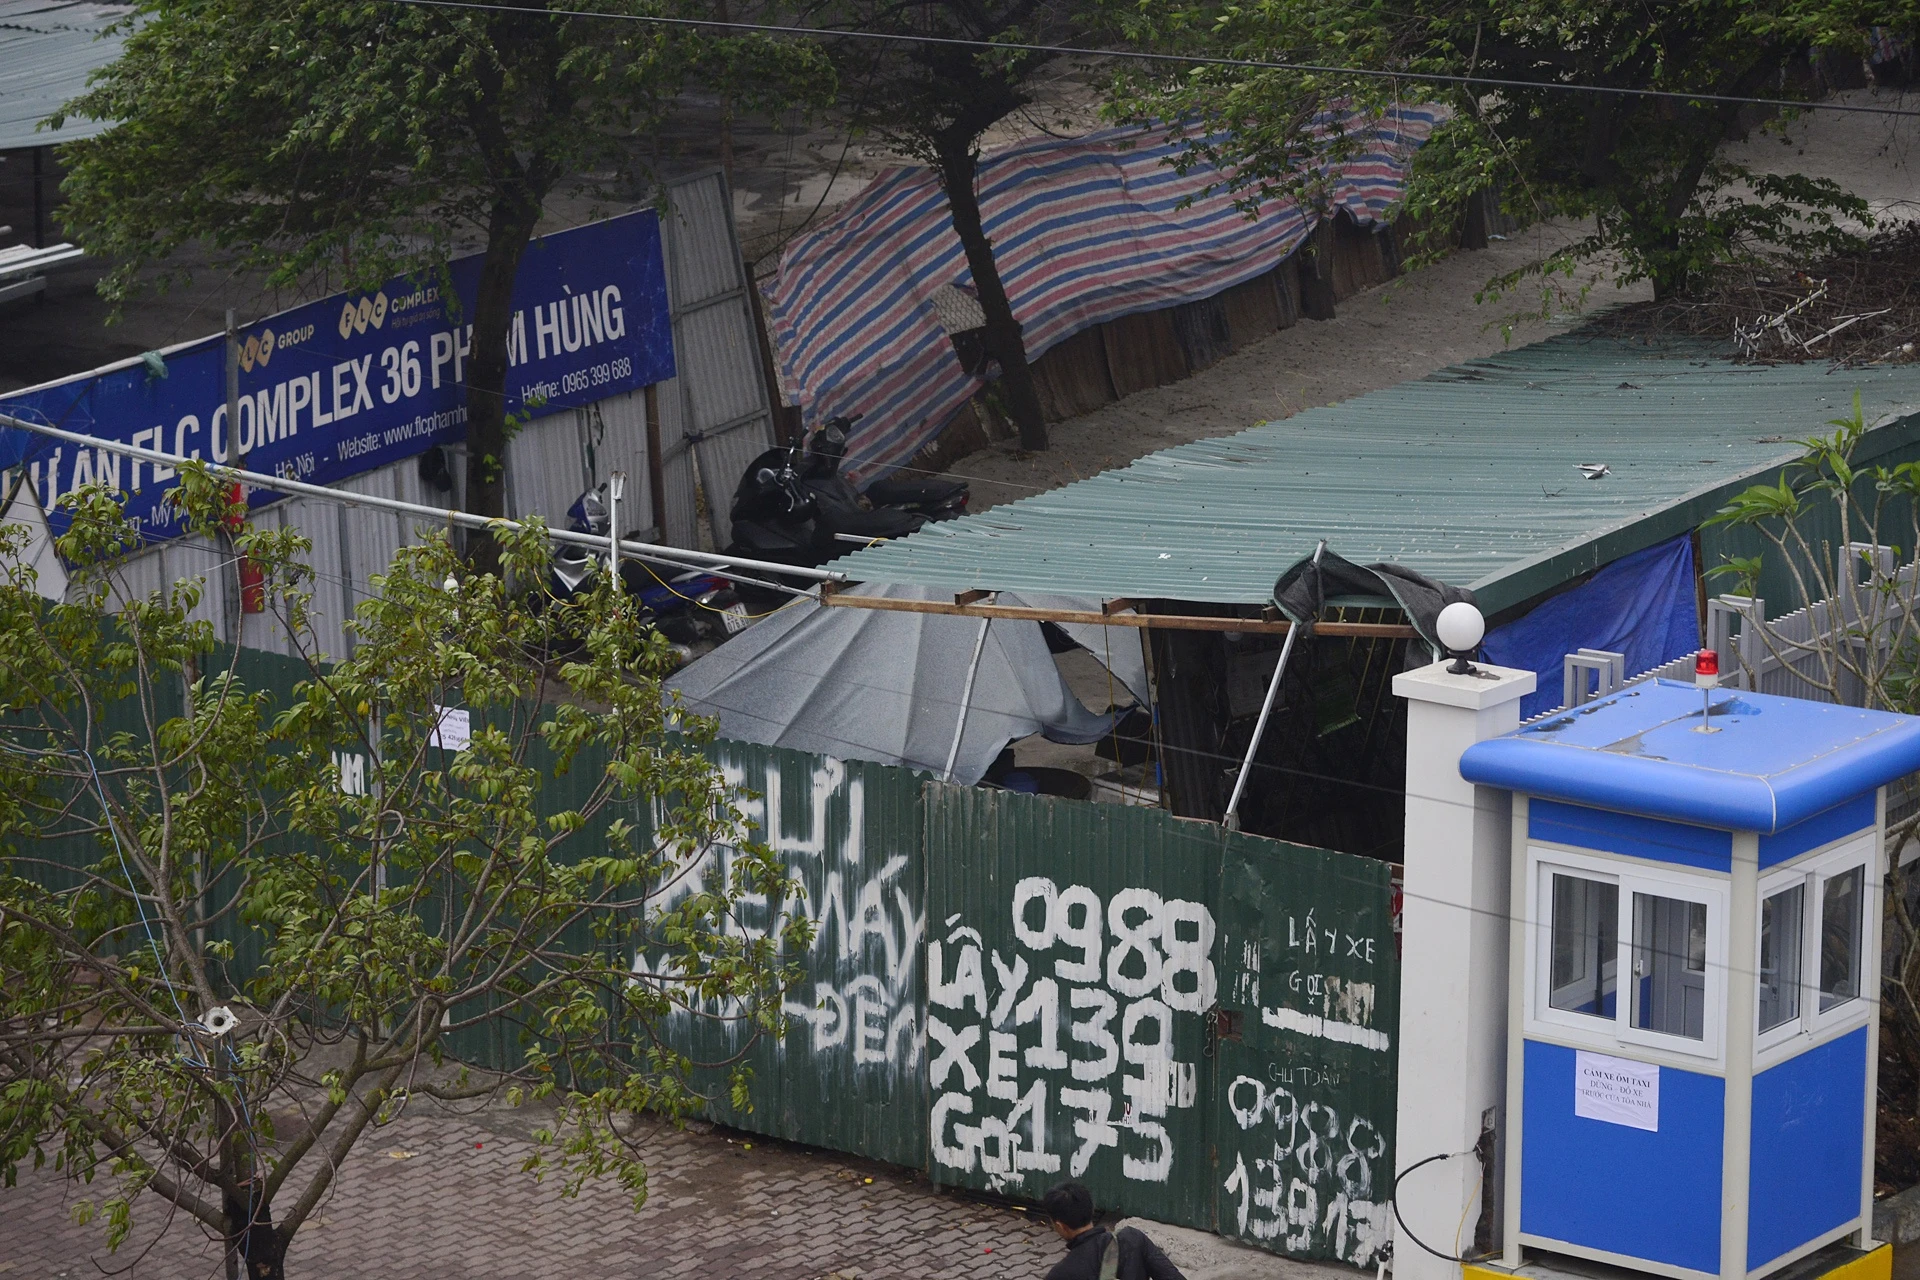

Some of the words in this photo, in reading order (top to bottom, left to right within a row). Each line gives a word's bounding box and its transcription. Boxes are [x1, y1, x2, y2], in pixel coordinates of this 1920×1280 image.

[277, 324, 315, 350] GROUP
[391, 286, 440, 314] COMPLEX
[131, 415, 201, 491] FLC
[210, 353, 374, 465] COMPLEX
[380, 340, 422, 404] 36
[430, 309, 529, 390] PHM
[534, 283, 626, 360] HÙNG
[296, 450, 316, 475] Nội
[337, 431, 382, 463] Website:
[521, 381, 561, 404] Hotline:
[562, 368, 590, 396] 0965
[590, 362, 611, 387] 399
[611, 356, 632, 380] 688
[776, 854, 927, 991] MÁY
[928, 912, 1029, 1030] LẤY
[1012, 876, 1218, 1015] 0988
[1345, 932, 1377, 965] XE
[928, 1014, 1018, 1103] XE
[1015, 976, 1174, 1098] 139
[1604, 1072, 1615, 1081] XE
[1630, 1077, 1651, 1088] TAXI
[1633, 1089, 1643, 1098] XE
[1227, 1075, 1387, 1200] 0988
